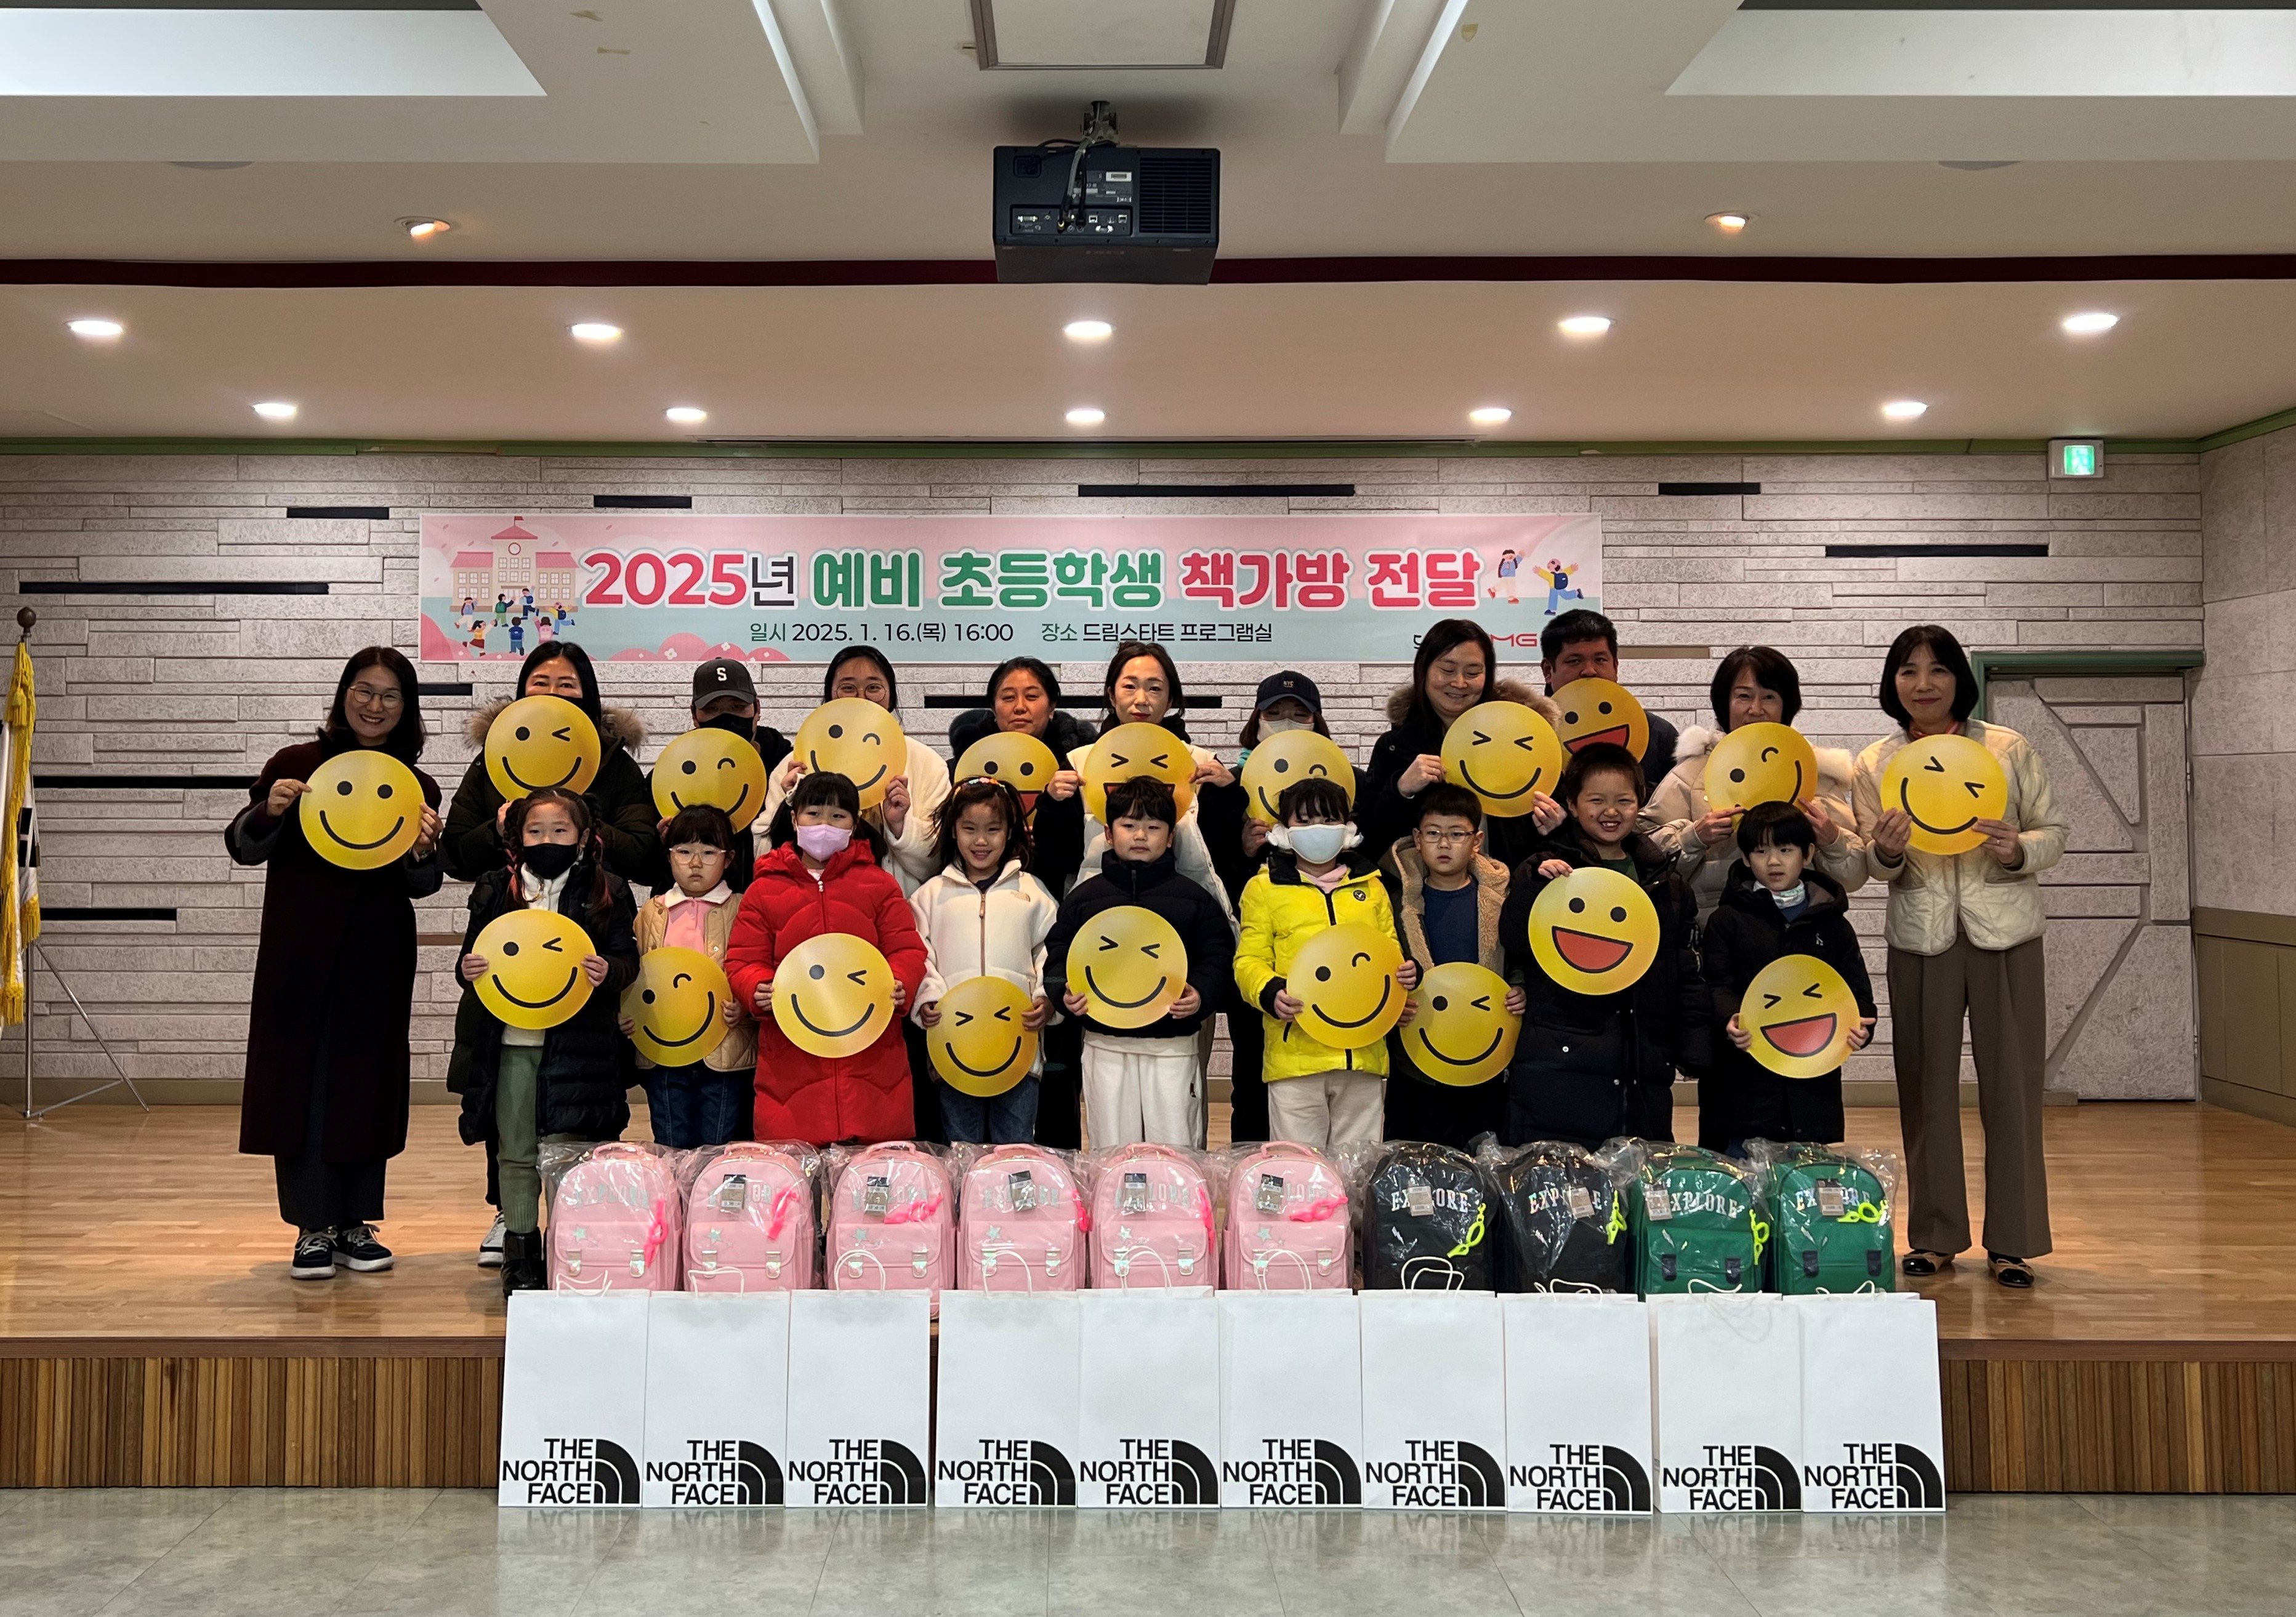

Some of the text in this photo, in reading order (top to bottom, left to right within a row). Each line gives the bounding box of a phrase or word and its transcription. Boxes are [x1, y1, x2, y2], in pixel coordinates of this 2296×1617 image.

[585, 552, 1480, 608] 2025년 예비 초등학생 책가방 전달
[750, 622, 1013, 643] 일시 2025. 1. 16.(목) 16:00
[1041, 623, 1272, 643] 장소 드림스타트 프로그램실
[716, 667, 727, 681] S
[544, 1438, 594, 1459] THE
[687, 1440, 736, 1461] THE
[829, 1438, 878, 1460] THE
[978, 1439, 1028, 1461] THE
[1119, 1438, 1169, 1460] THE
[1262, 1438, 1312, 1459] THE
[1405, 1440, 1455, 1462] THE
[1549, 1444, 1600, 1466] THE
[1702, 1445, 1752, 1466] THE
[1843, 1443, 1893, 1464] THE
[502, 1460, 592, 1482] NORTH
[646, 1461, 736, 1482] NORTH
[789, 1461, 878, 1482] NORTH
[938, 1460, 1028, 1482] NORTH
[1080, 1461, 1169, 1482] NORTH
[1223, 1461, 1312, 1483] NORTH
[1366, 1462, 1456, 1485] NORTH
[1510, 1466, 1601, 1488] NORTH
[1662, 1467, 1752, 1488] NORTH
[1804, 1465, 1894, 1487] NORTH
[528, 1482, 592, 1504] FACE
[672, 1483, 735, 1506] FACE
[814, 1483, 877, 1505] FACE
[964, 1482, 1027, 1505] FACE
[1106, 1483, 1169, 1505] FACE
[1249, 1483, 1313, 1506] FACE
[1392, 1485, 1456, 1507] FACE
[1537, 1488, 1601, 1511] FACE
[1690, 1489, 1753, 1511] FACE
[1831, 1487, 1895, 1509] FACE
